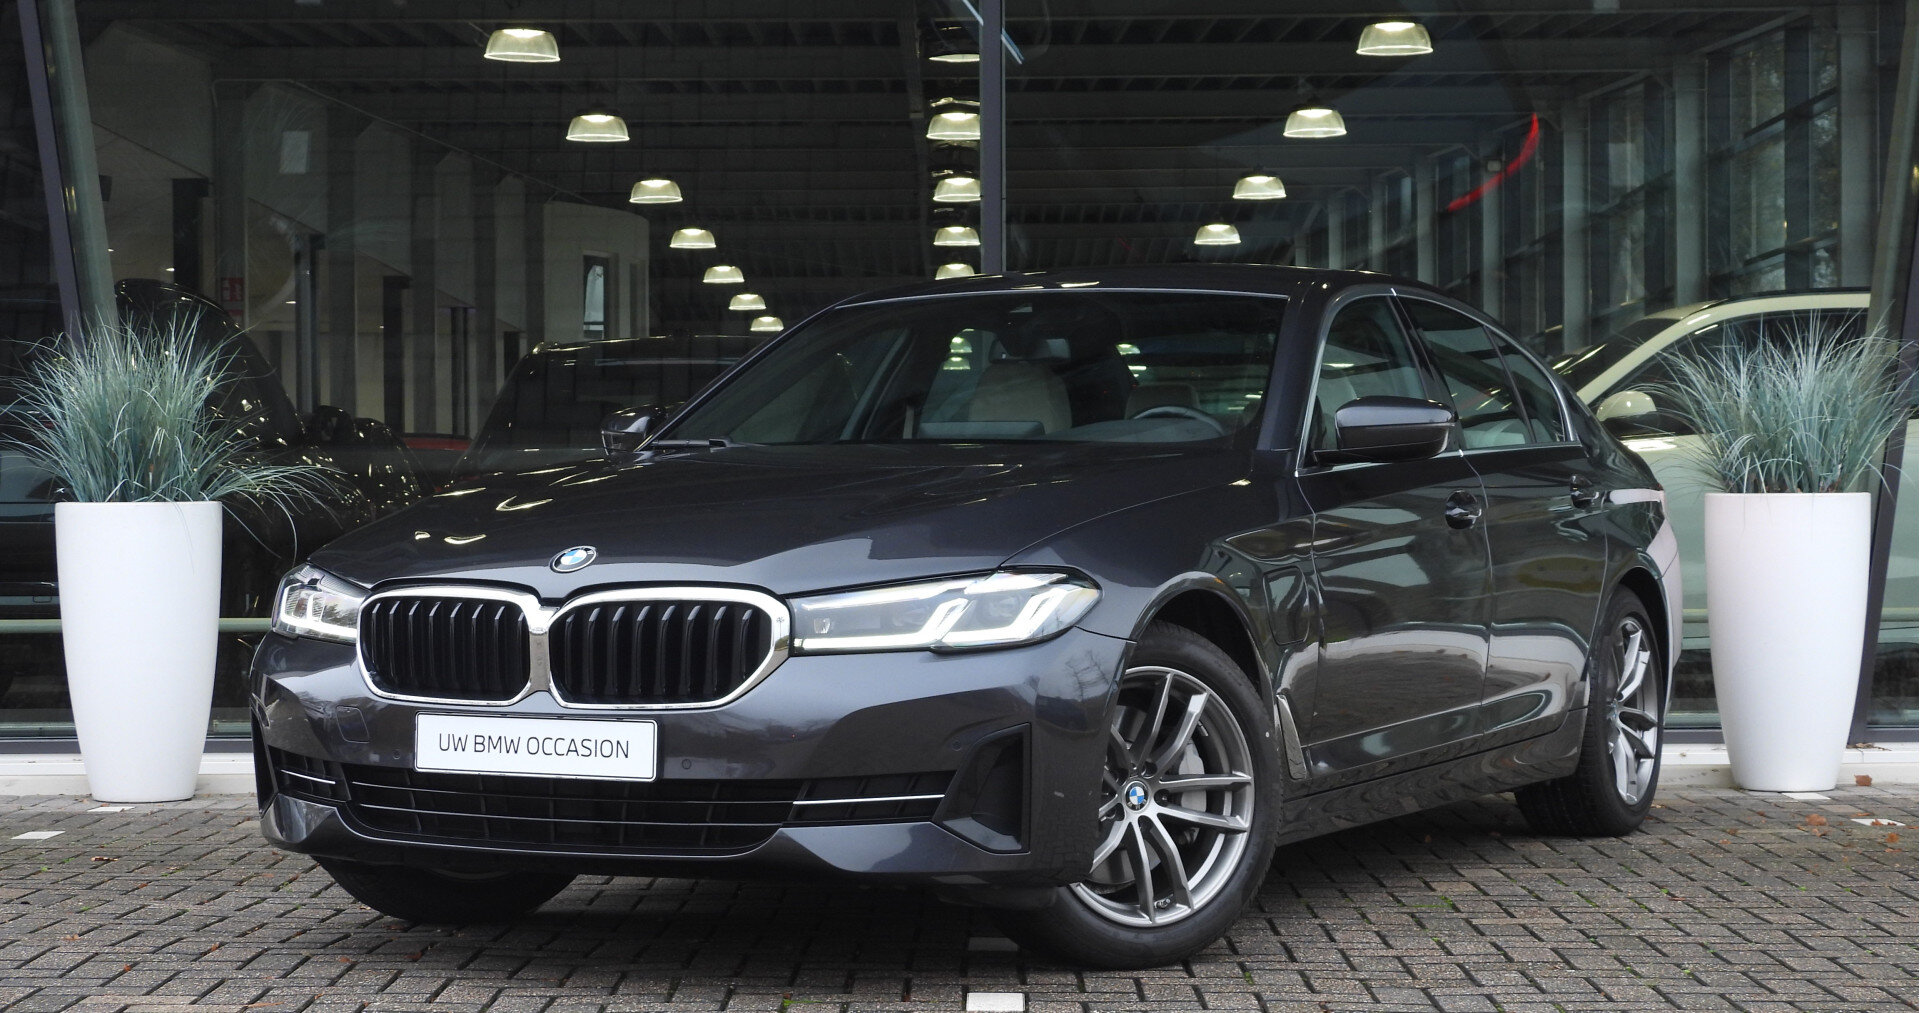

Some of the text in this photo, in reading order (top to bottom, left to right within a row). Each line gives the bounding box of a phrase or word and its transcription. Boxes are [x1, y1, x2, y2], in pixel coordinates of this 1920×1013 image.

[438, 733, 629, 759] UW BMW OCCASION
